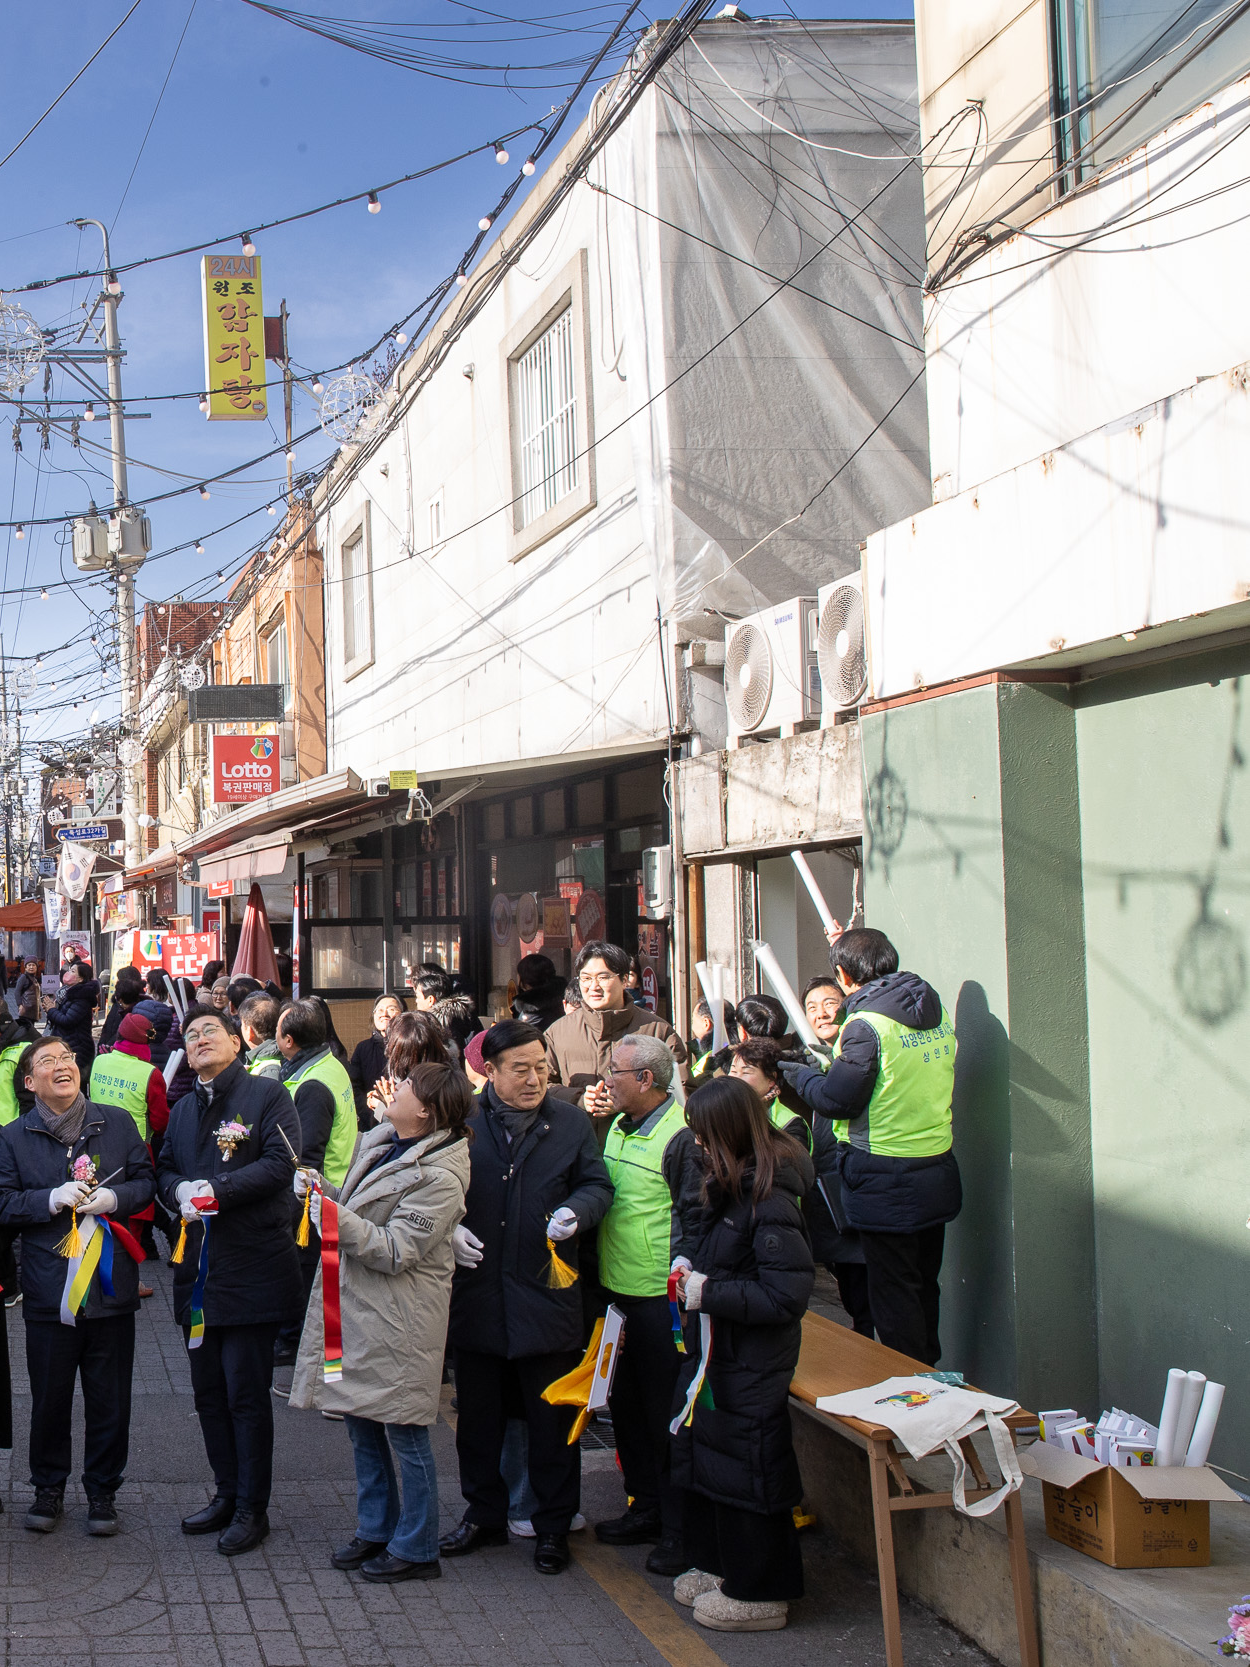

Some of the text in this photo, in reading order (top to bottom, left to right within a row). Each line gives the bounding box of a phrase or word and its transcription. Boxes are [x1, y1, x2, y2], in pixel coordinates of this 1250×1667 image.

[210, 257, 255, 277] 24시
[212, 280, 255, 297] 원조
[215, 298, 261, 410] 감자탕
[774, 613, 793, 625] SAMSUNG
[221, 762, 272, 778] Lotto
[222, 782, 272, 793] 복권판매점
[899, 1030, 932, 1049] 자양한강
[93, 1073, 138, 1092] 자양한강 전통시장
[410, 1212, 435, 1232] SEOUL
